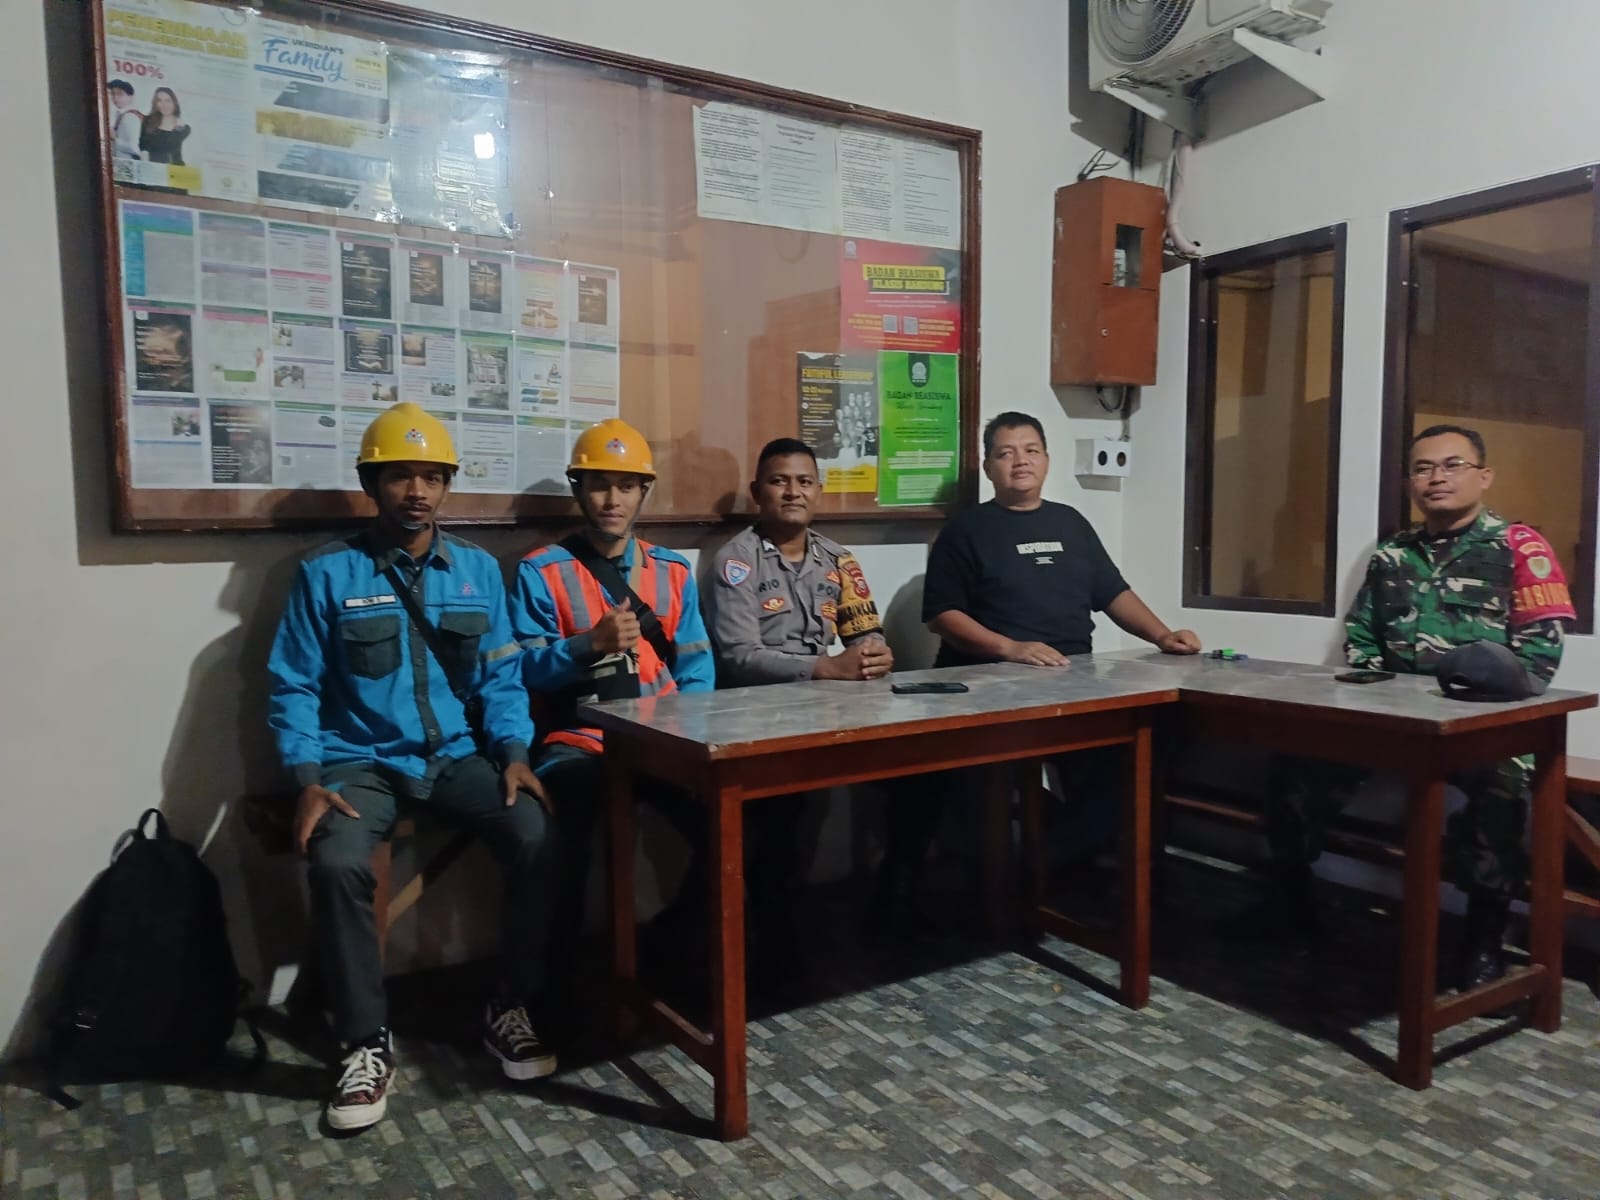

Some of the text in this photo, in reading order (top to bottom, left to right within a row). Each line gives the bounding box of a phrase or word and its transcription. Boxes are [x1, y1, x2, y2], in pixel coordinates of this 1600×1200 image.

[113, 59, 165, 80] 100%
[262, 38, 346, 81] Family
[758, 578, 780, 593] RIO
